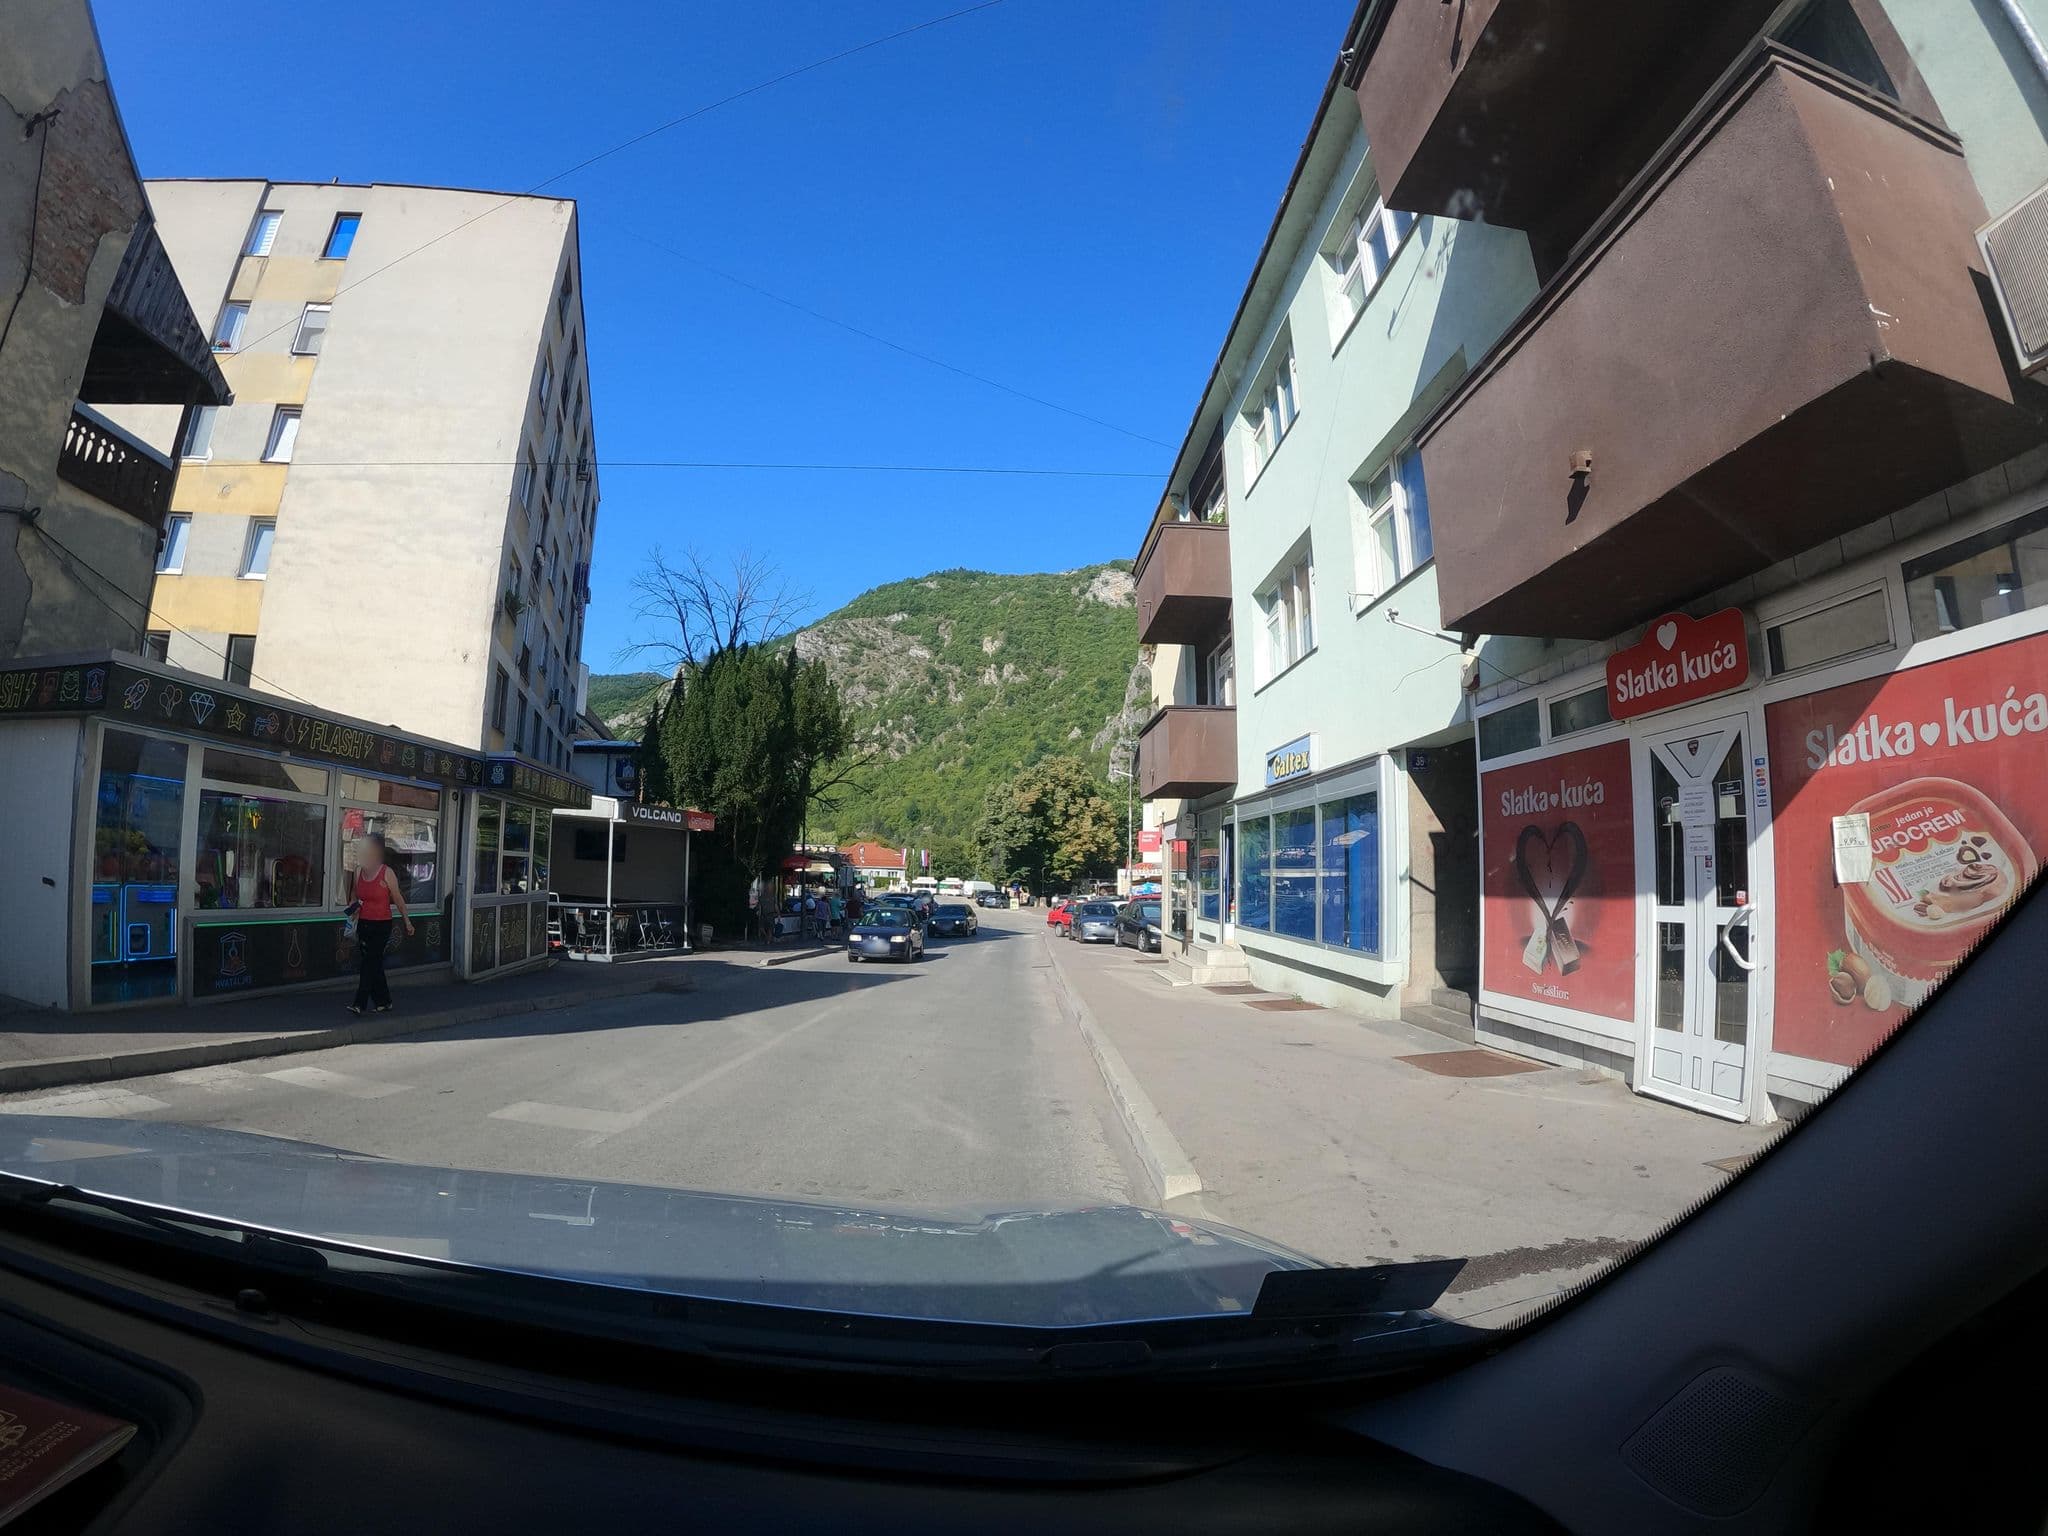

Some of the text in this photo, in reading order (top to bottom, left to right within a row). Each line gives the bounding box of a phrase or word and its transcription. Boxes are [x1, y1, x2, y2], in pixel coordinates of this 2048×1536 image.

[1616, 640, 1737, 703] Slatka kuća
[310, 720, 364, 759] FLASH
[1806, 685, 2048, 770] Slatka kuća
[1273, 750, 1310, 779] Galtex
[632, 806, 682, 823] VOLCANO
[1501, 776, 1605, 817] Slatka kuća
[1895, 806, 1934, 827] Jedan je
[1872, 809, 1966, 854] UROCREM
